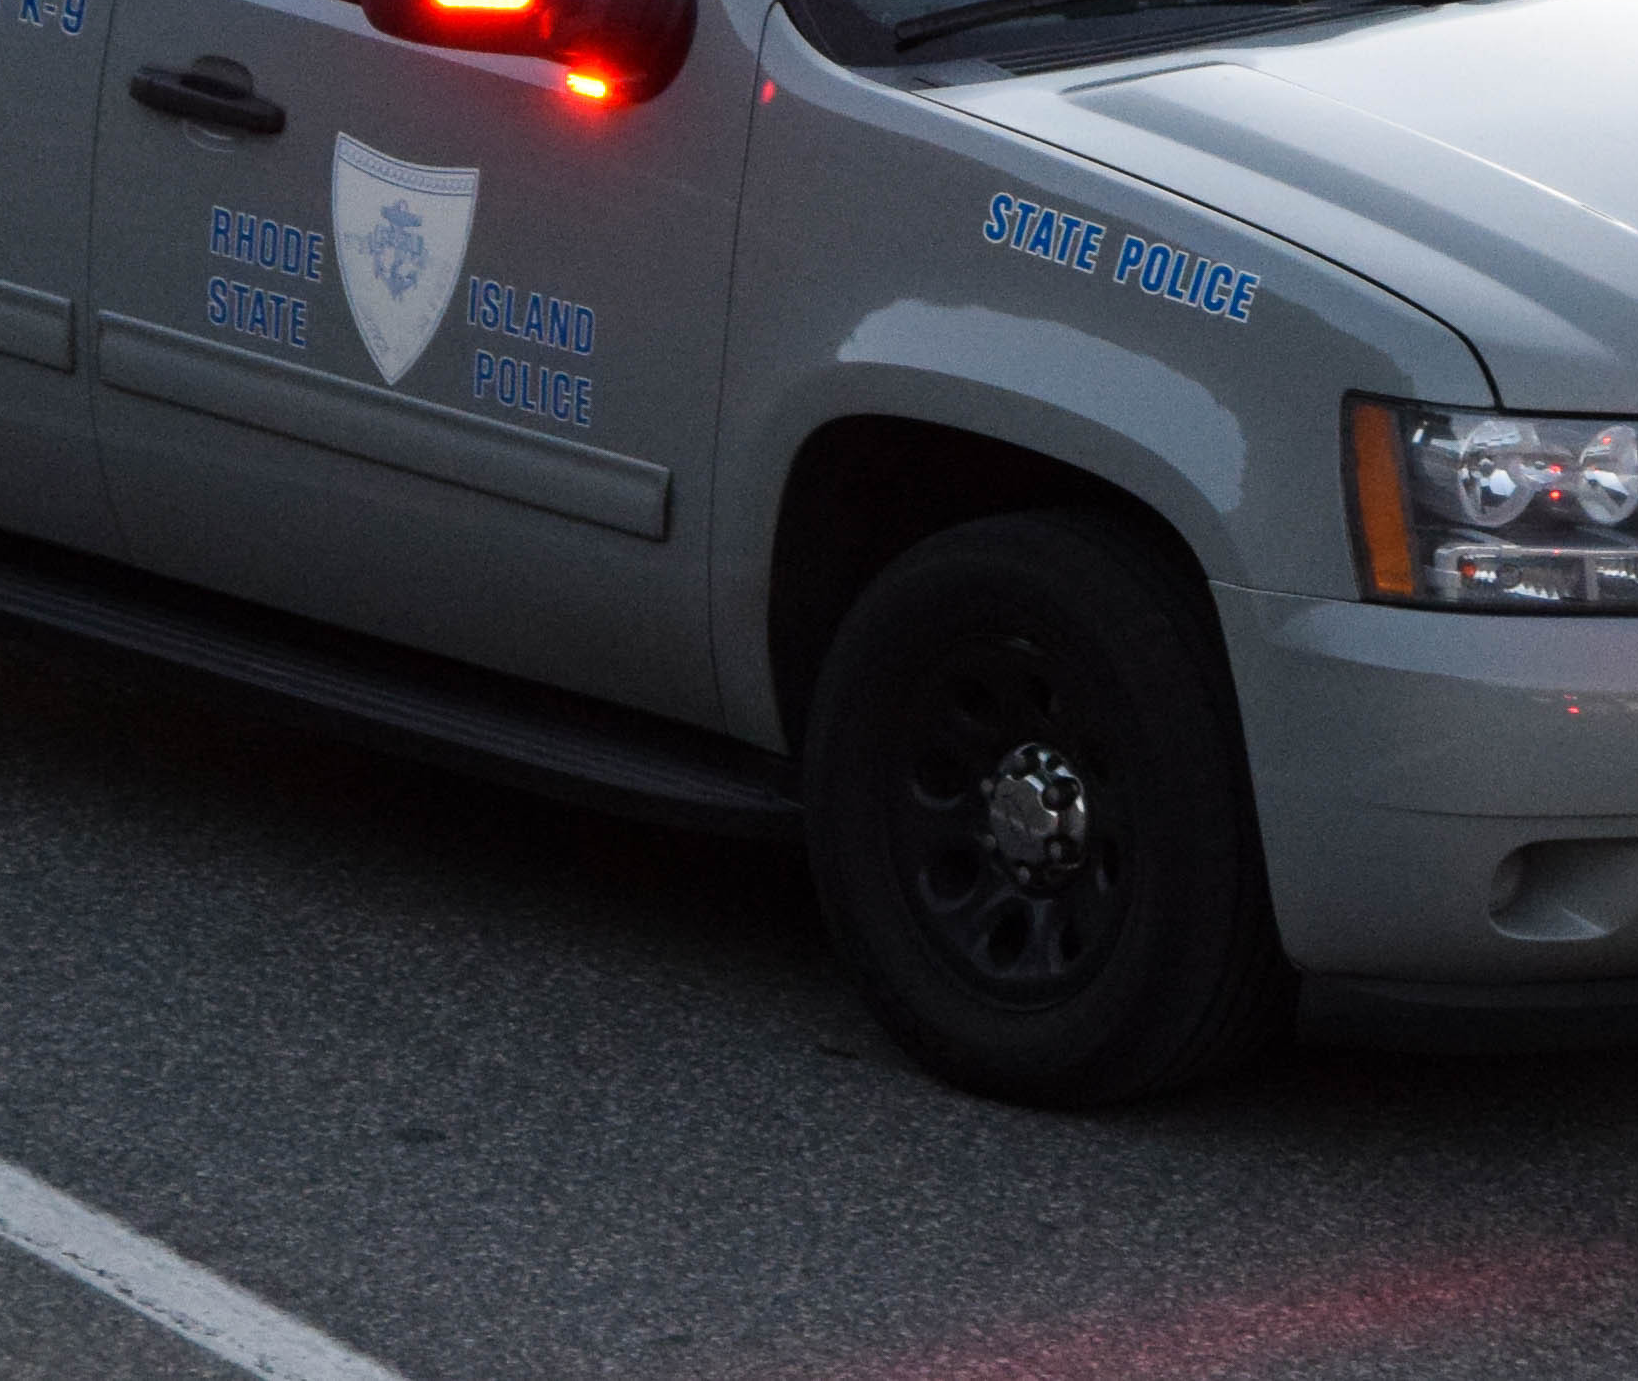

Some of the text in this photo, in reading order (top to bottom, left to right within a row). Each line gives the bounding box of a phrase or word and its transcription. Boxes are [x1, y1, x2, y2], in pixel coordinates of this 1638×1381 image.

[210, 205, 324, 284] RHODE
[983, 192, 1260, 323] STATE POLICE
[207, 275, 308, 349] STATE
[467, 275, 595, 356] ISLAND
[474, 348, 592, 427] POLICE
